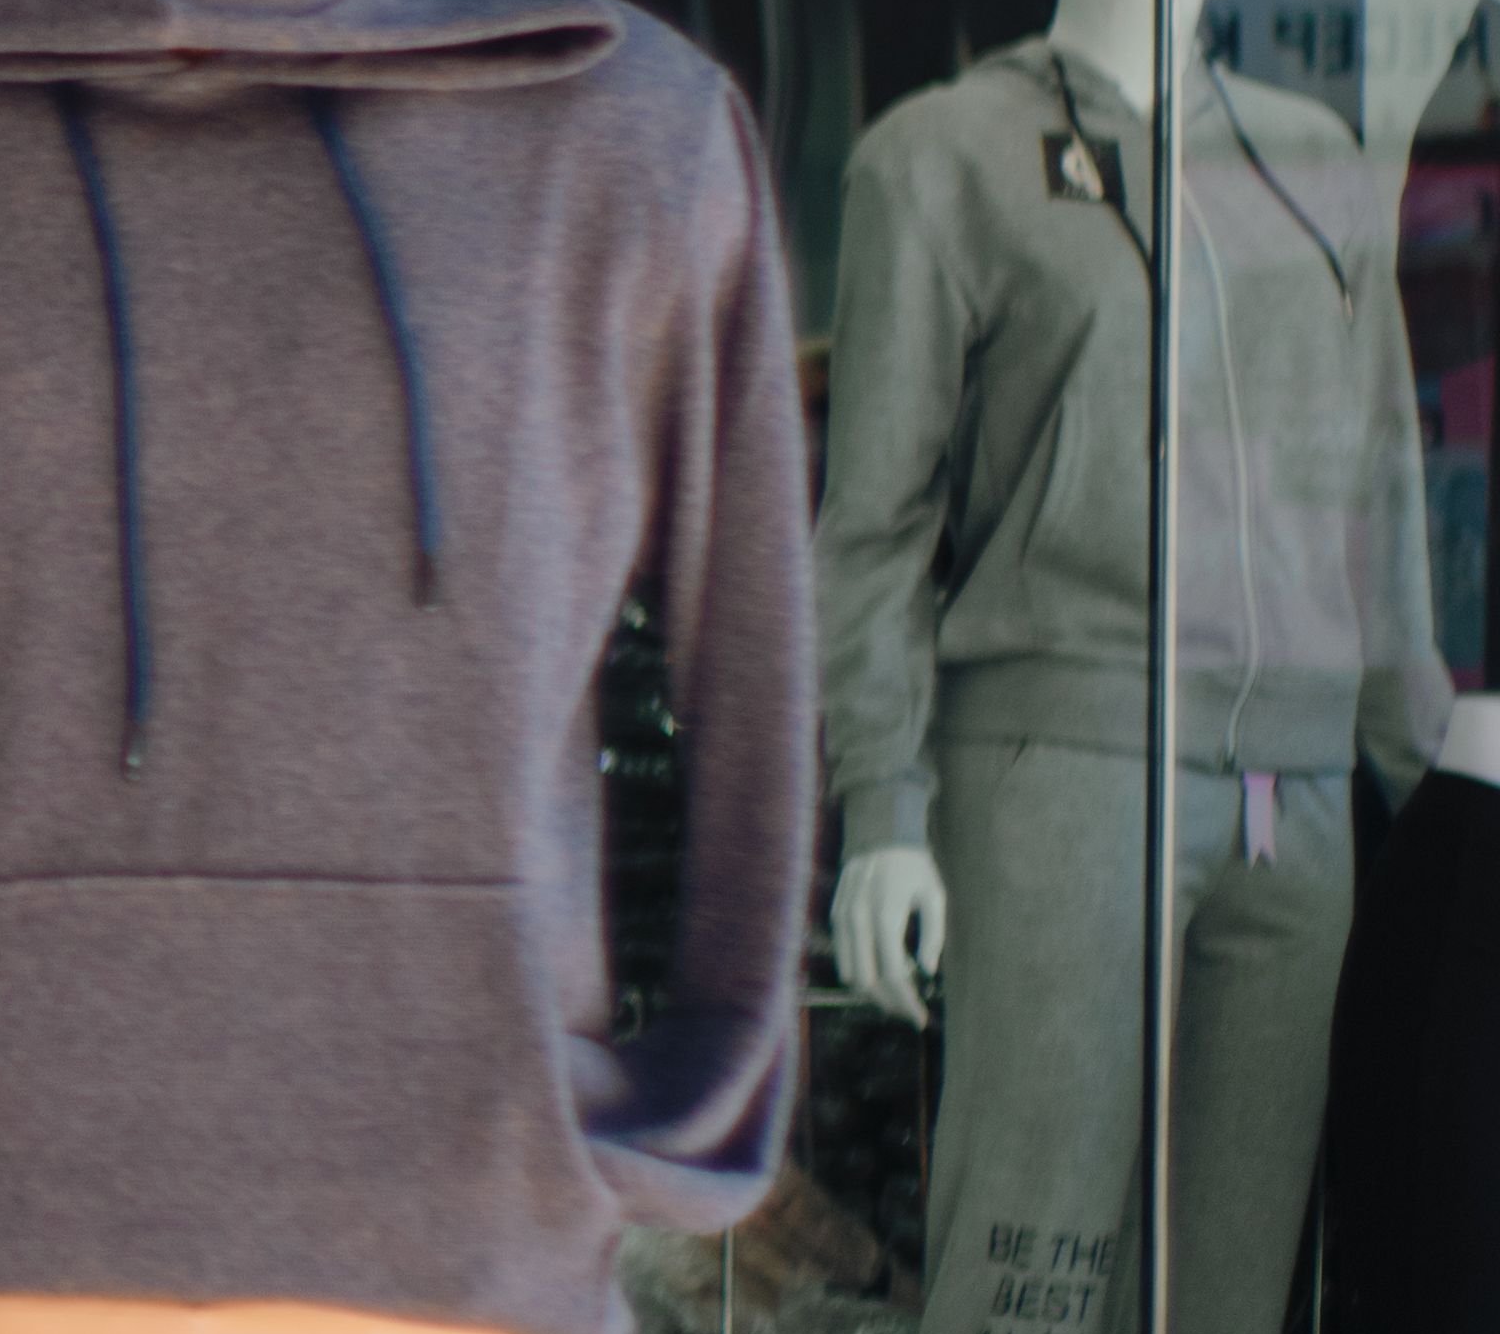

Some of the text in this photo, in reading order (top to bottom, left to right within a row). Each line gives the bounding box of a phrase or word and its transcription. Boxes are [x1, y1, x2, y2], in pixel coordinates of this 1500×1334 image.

[988, 1222, 1115, 1275] BE THE
[991, 1273, 1097, 1323] BEST
